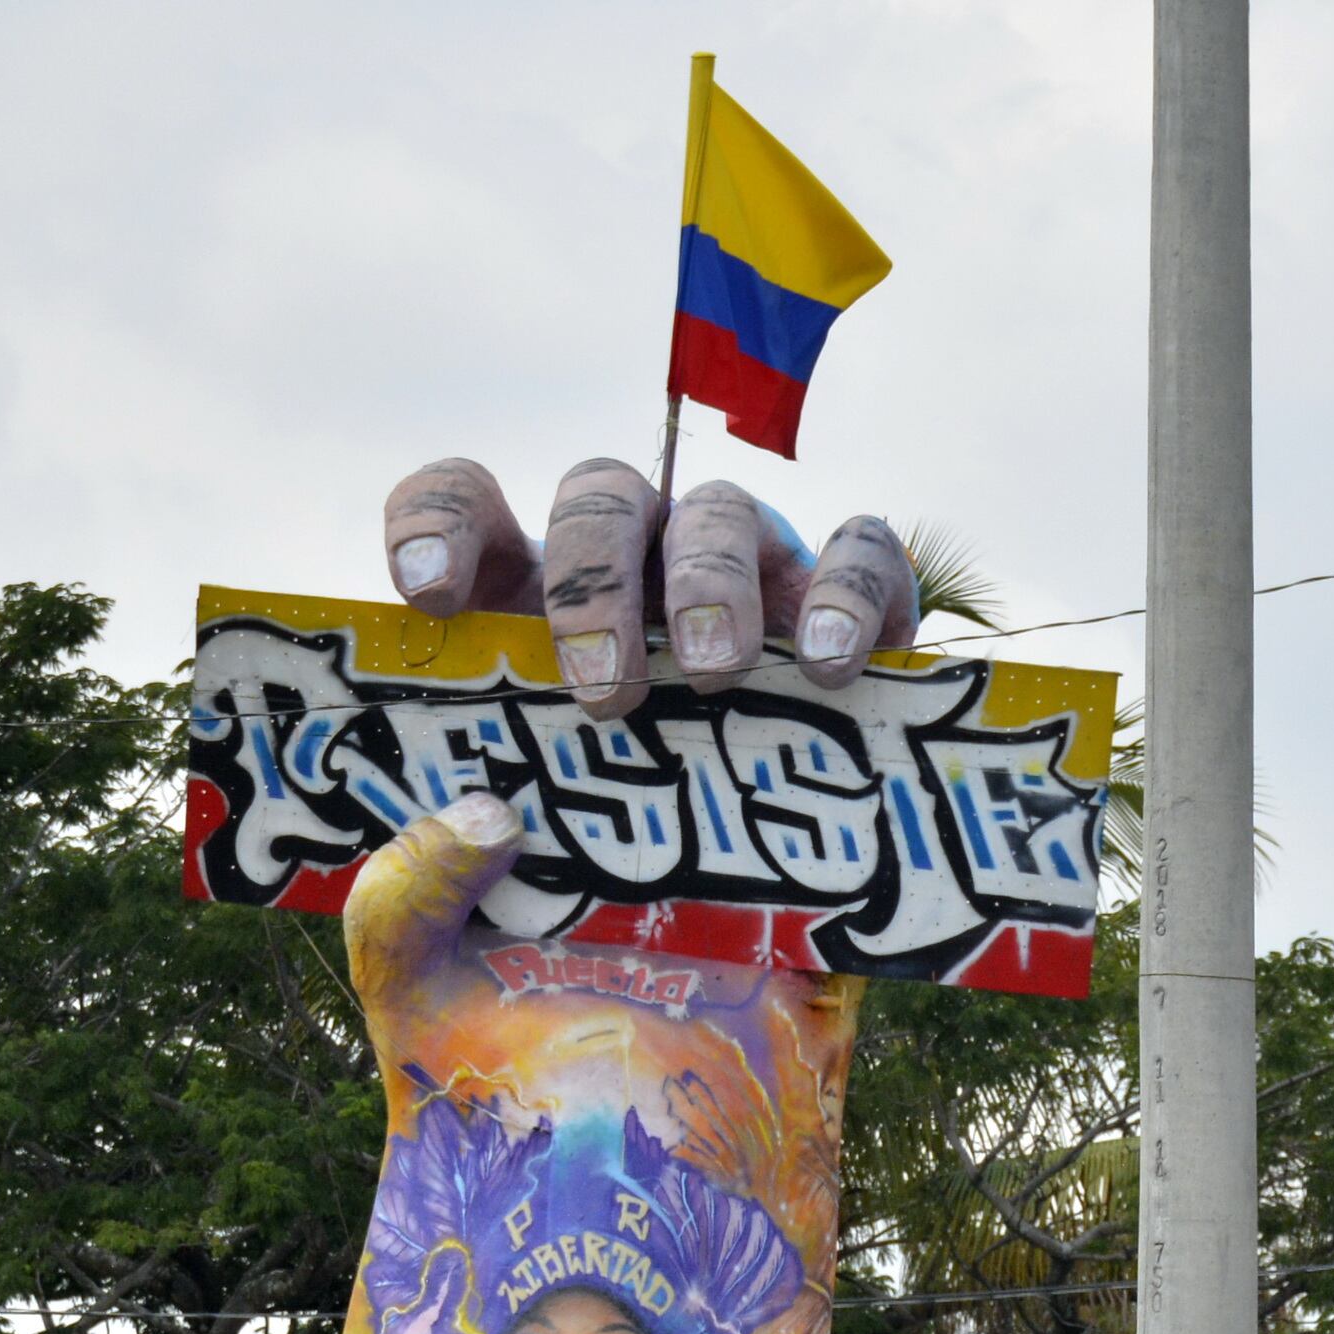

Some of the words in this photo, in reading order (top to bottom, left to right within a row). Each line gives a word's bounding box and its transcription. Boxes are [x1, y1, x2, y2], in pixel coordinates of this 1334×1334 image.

[193, 618, 1107, 955] RESISTE
[504, 1199, 534, 1253] P
[615, 1191, 652, 1242] R
[497, 1230, 677, 1317] LIBERTAD
